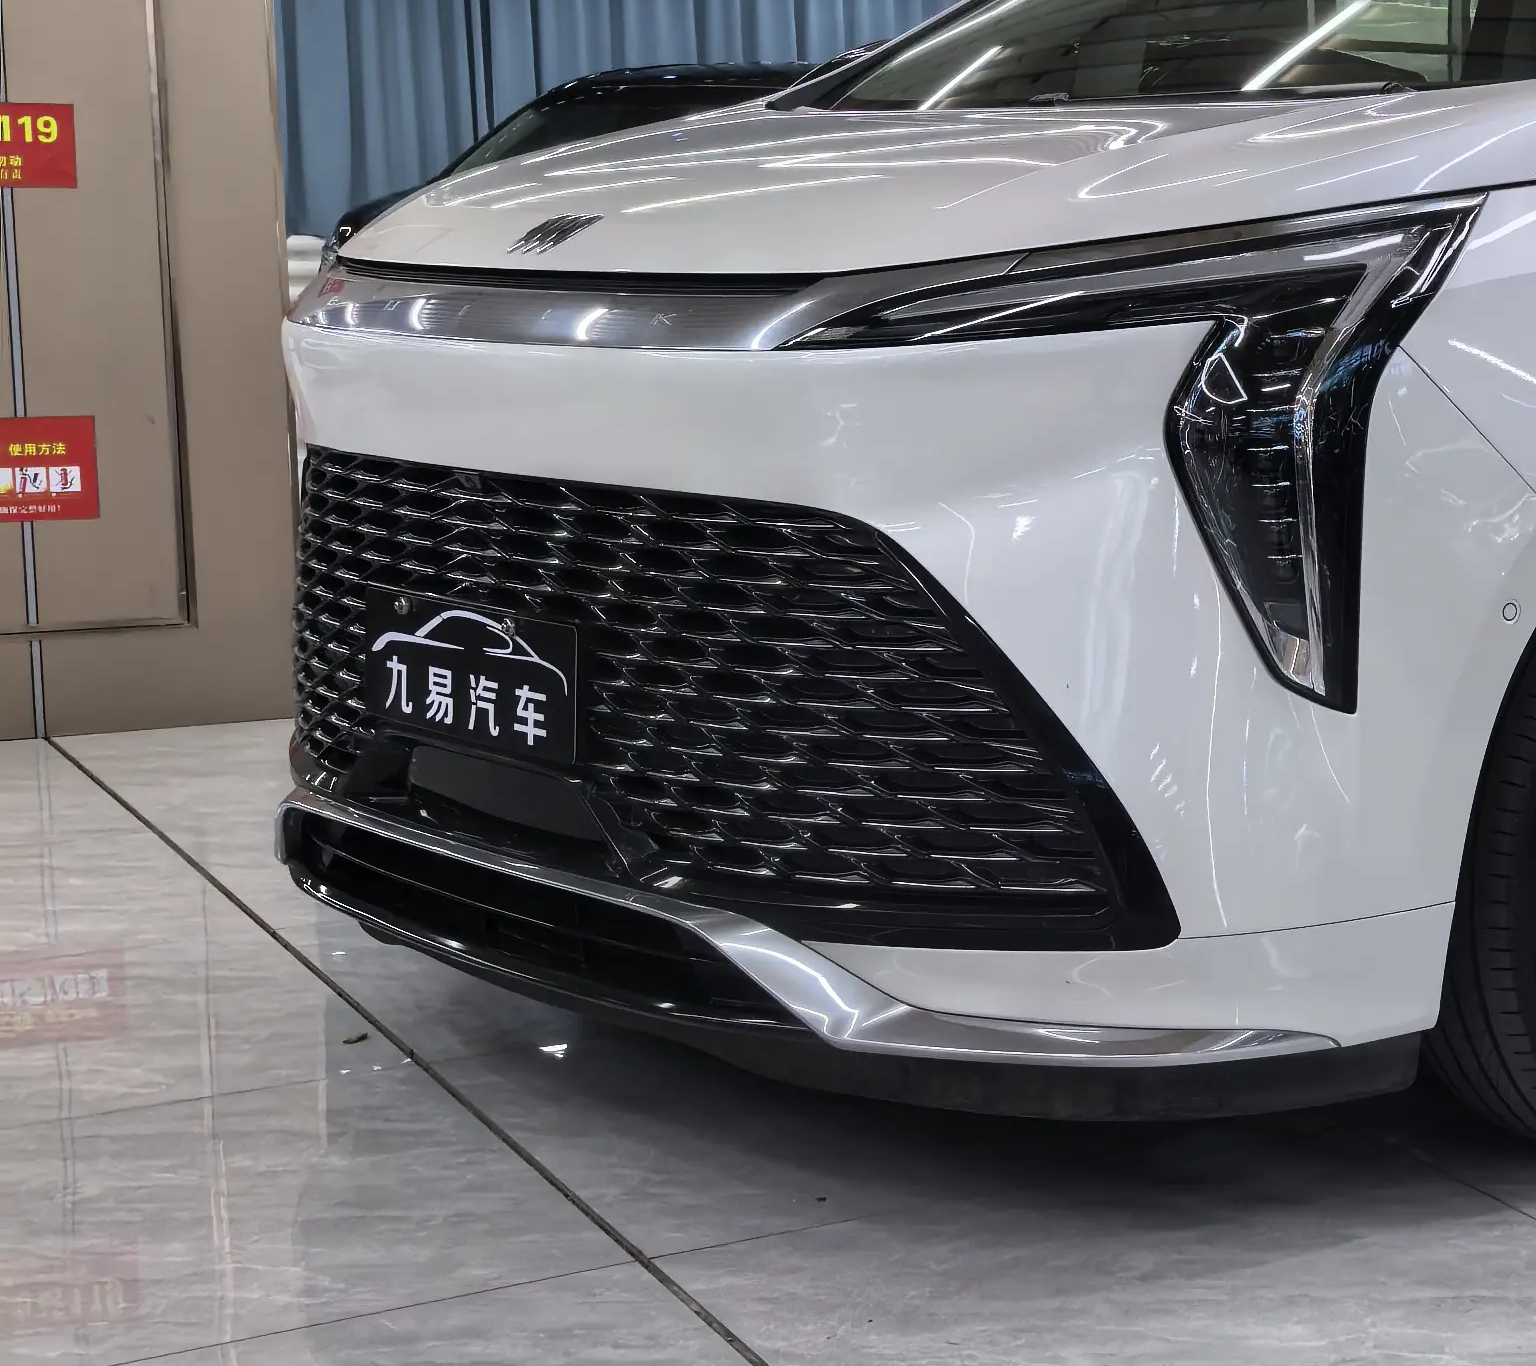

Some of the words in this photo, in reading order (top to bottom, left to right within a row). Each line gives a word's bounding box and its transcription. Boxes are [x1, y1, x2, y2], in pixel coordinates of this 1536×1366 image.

[9, 442, 66, 456] 使用方法
[385, 655, 547, 746] 九易汽车
